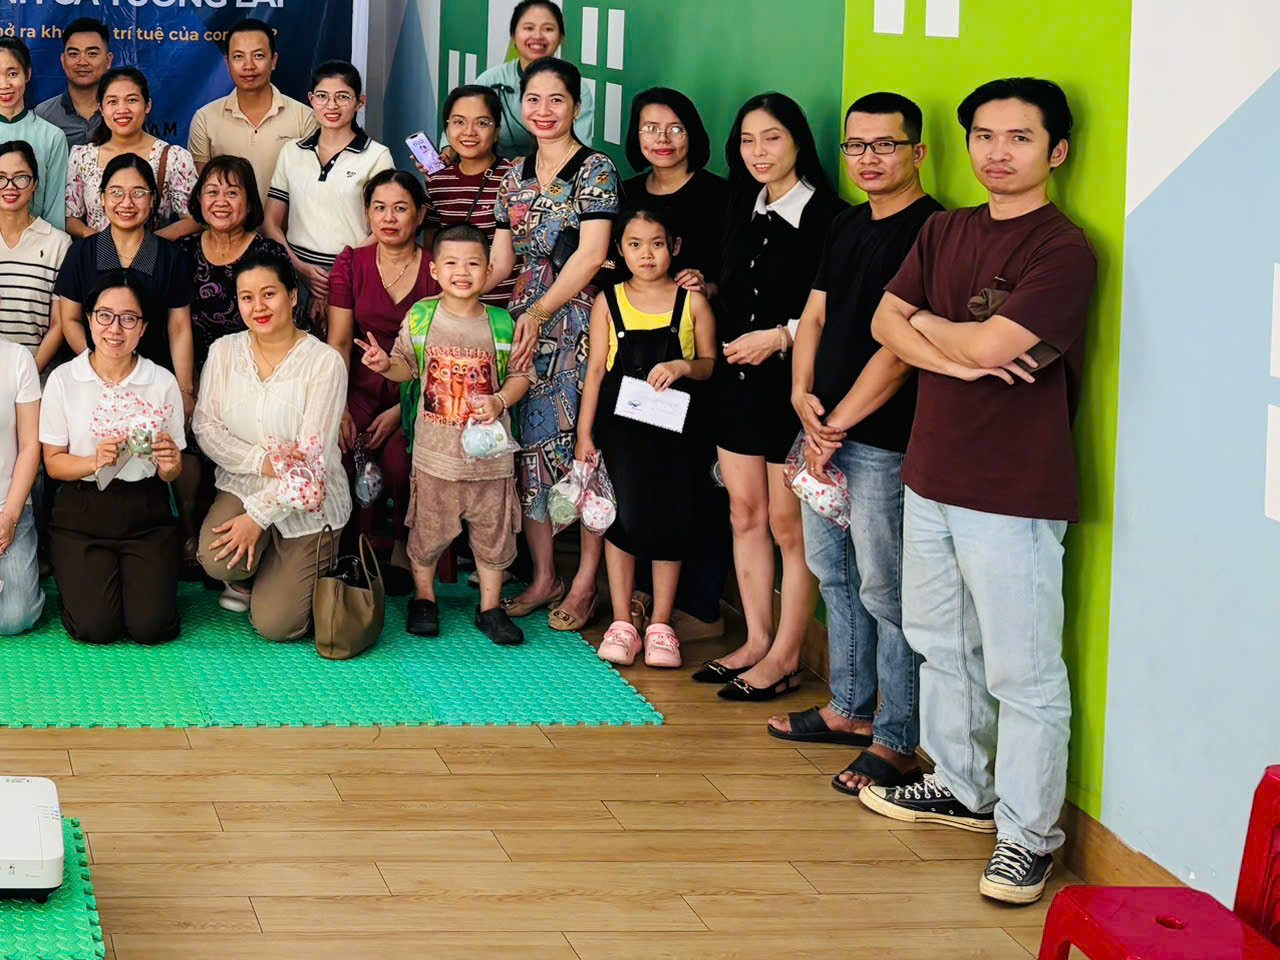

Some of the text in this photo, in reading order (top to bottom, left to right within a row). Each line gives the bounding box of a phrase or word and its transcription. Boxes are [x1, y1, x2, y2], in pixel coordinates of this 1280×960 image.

[20, 27, 36, 38] ra
[113, 26, 133, 40] trí
[136, 26, 164, 43] tuệ
[169, 26, 199, 40] của
